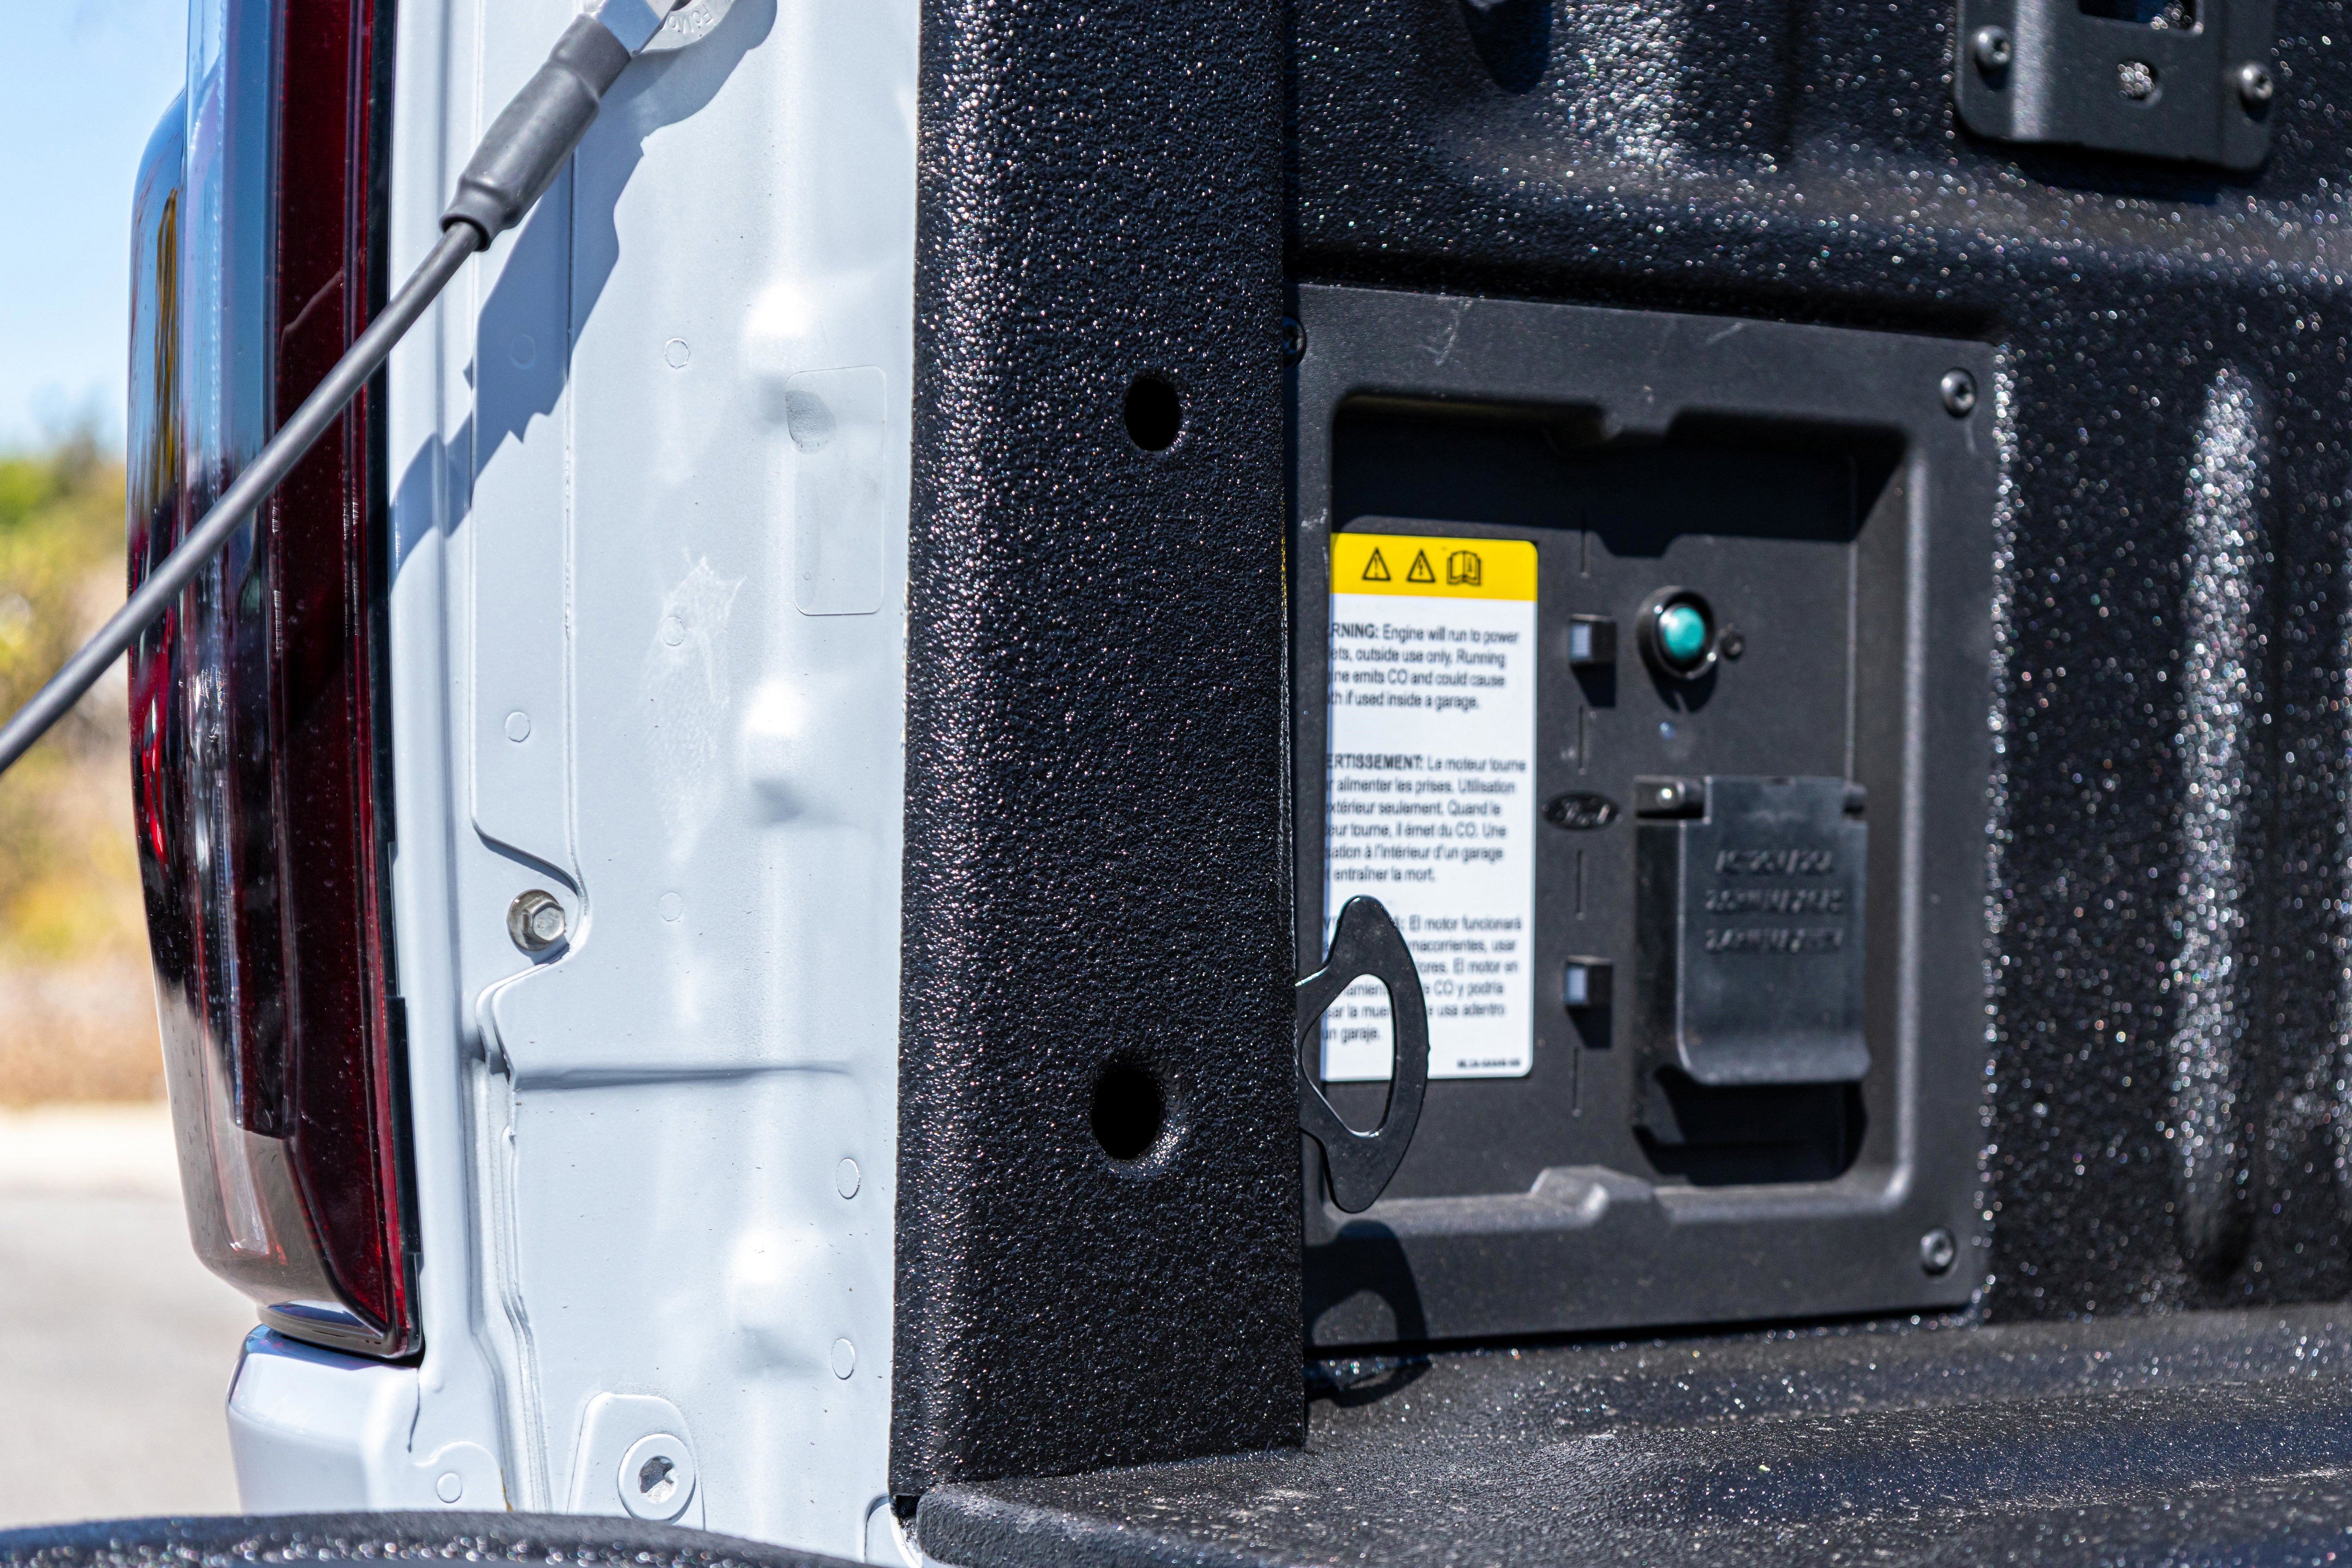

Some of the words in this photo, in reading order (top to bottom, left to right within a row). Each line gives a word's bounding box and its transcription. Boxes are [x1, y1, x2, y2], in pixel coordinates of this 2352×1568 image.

[1383, 624, 1423, 644] Engine
[1428, 626, 1446, 641] will
[1448, 629, 1467, 642] run
[1470, 628, 1480, 642] to
[1483, 630, 1518, 646] power
[1355, 646, 1399, 662] outside
[1402, 650, 1423, 663] use
[1456, 648, 1505, 668] Running
[1330, 670, 1349, 683] ne
[1352, 668, 1384, 684] emits
[1388, 668, 1408, 685] CO
[1410, 670, 1432, 686] and
[1436, 670, 1467, 686] could
[1470, 675, 1505, 687] cause
[1345, 689, 1353, 705] if
[1354, 692, 1383, 706] used
[1387, 691, 1421, 707] inside
[1425, 695, 1432, 708] a
[1435, 695, 1480, 713] garage.
[1428, 755, 1442, 771] Le
[1446, 756, 1486, 771] moteur
[1489, 756, 1526, 773] tourne
[1337, 776, 1392, 792] alimenter
[1395, 776, 1412, 792] les
[1458, 777, 1515, 795] Utilisation
[1448, 799, 1488, 816] Quand
[1490, 801, 1501, 816] le
[1327, 824, 1348, 836] eur
[1405, 820, 1434, 836] émet
[1438, 822, 1452, 837] du
[1483, 822, 1507, 839] Une
[1363, 844, 1372, 859] à
[1461, 847, 1504, 864] garage
[1333, 865, 1388, 882] entraîner
[1391, 866, 1401, 882] la
[1404, 866, 1436, 883] mort.
[1409, 914, 1421, 932] El
[1424, 916, 1458, 932] motor
[1491, 940, 1516, 953] usar
[1453, 958, 1464, 976] El
[1468, 960, 1501, 974] motor
[1504, 961, 1518, 974] en
[1434, 979, 1453, 997] CO
[1457, 983, 1463, 999] y
[1348, 1002, 1357, 1018] la
[1361, 1005, 1390, 1018] mue
[1437, 1004, 1458, 1017] usa
